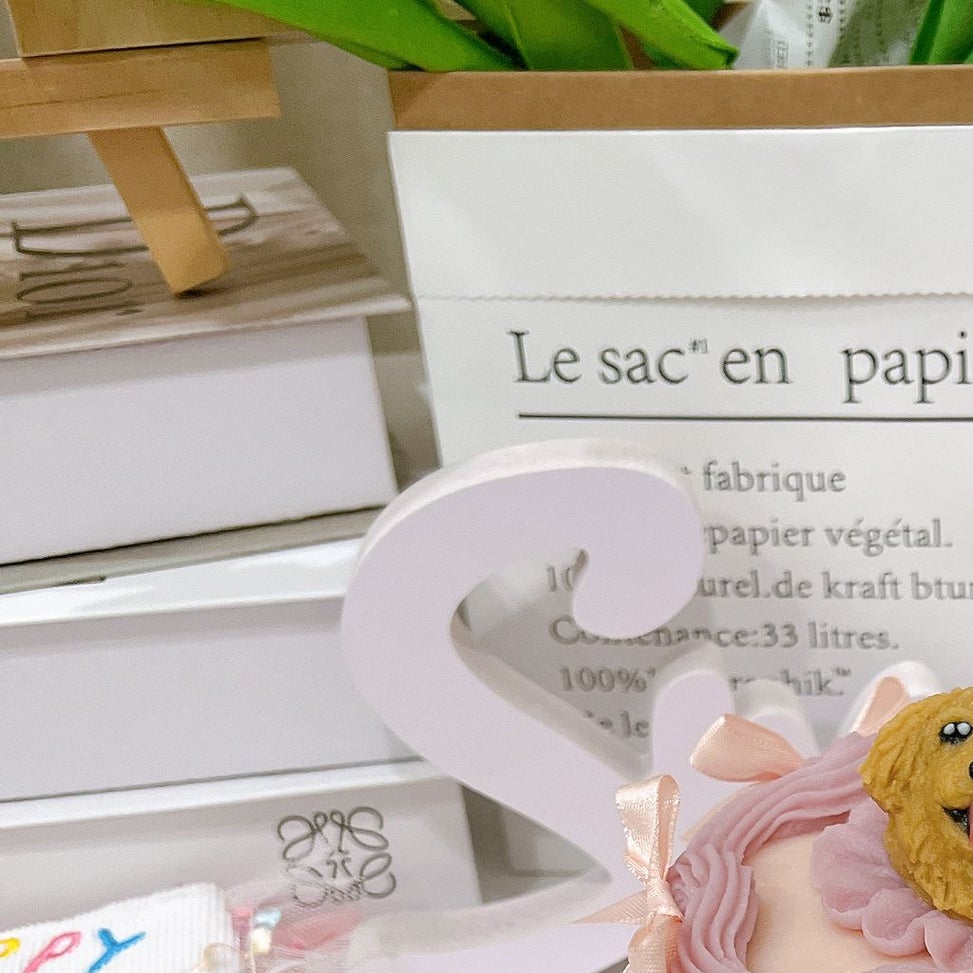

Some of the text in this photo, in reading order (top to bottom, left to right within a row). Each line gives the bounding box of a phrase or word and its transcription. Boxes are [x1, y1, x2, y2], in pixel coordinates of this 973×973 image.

[507, 329, 582, 384] Le
[722, 346, 791, 385] en
[702, 459, 847, 502] fabrique
[824, 516, 954, 557] végétal.
[822, 571, 903, 601] kraft
[808, 621, 899, 650] litres.
